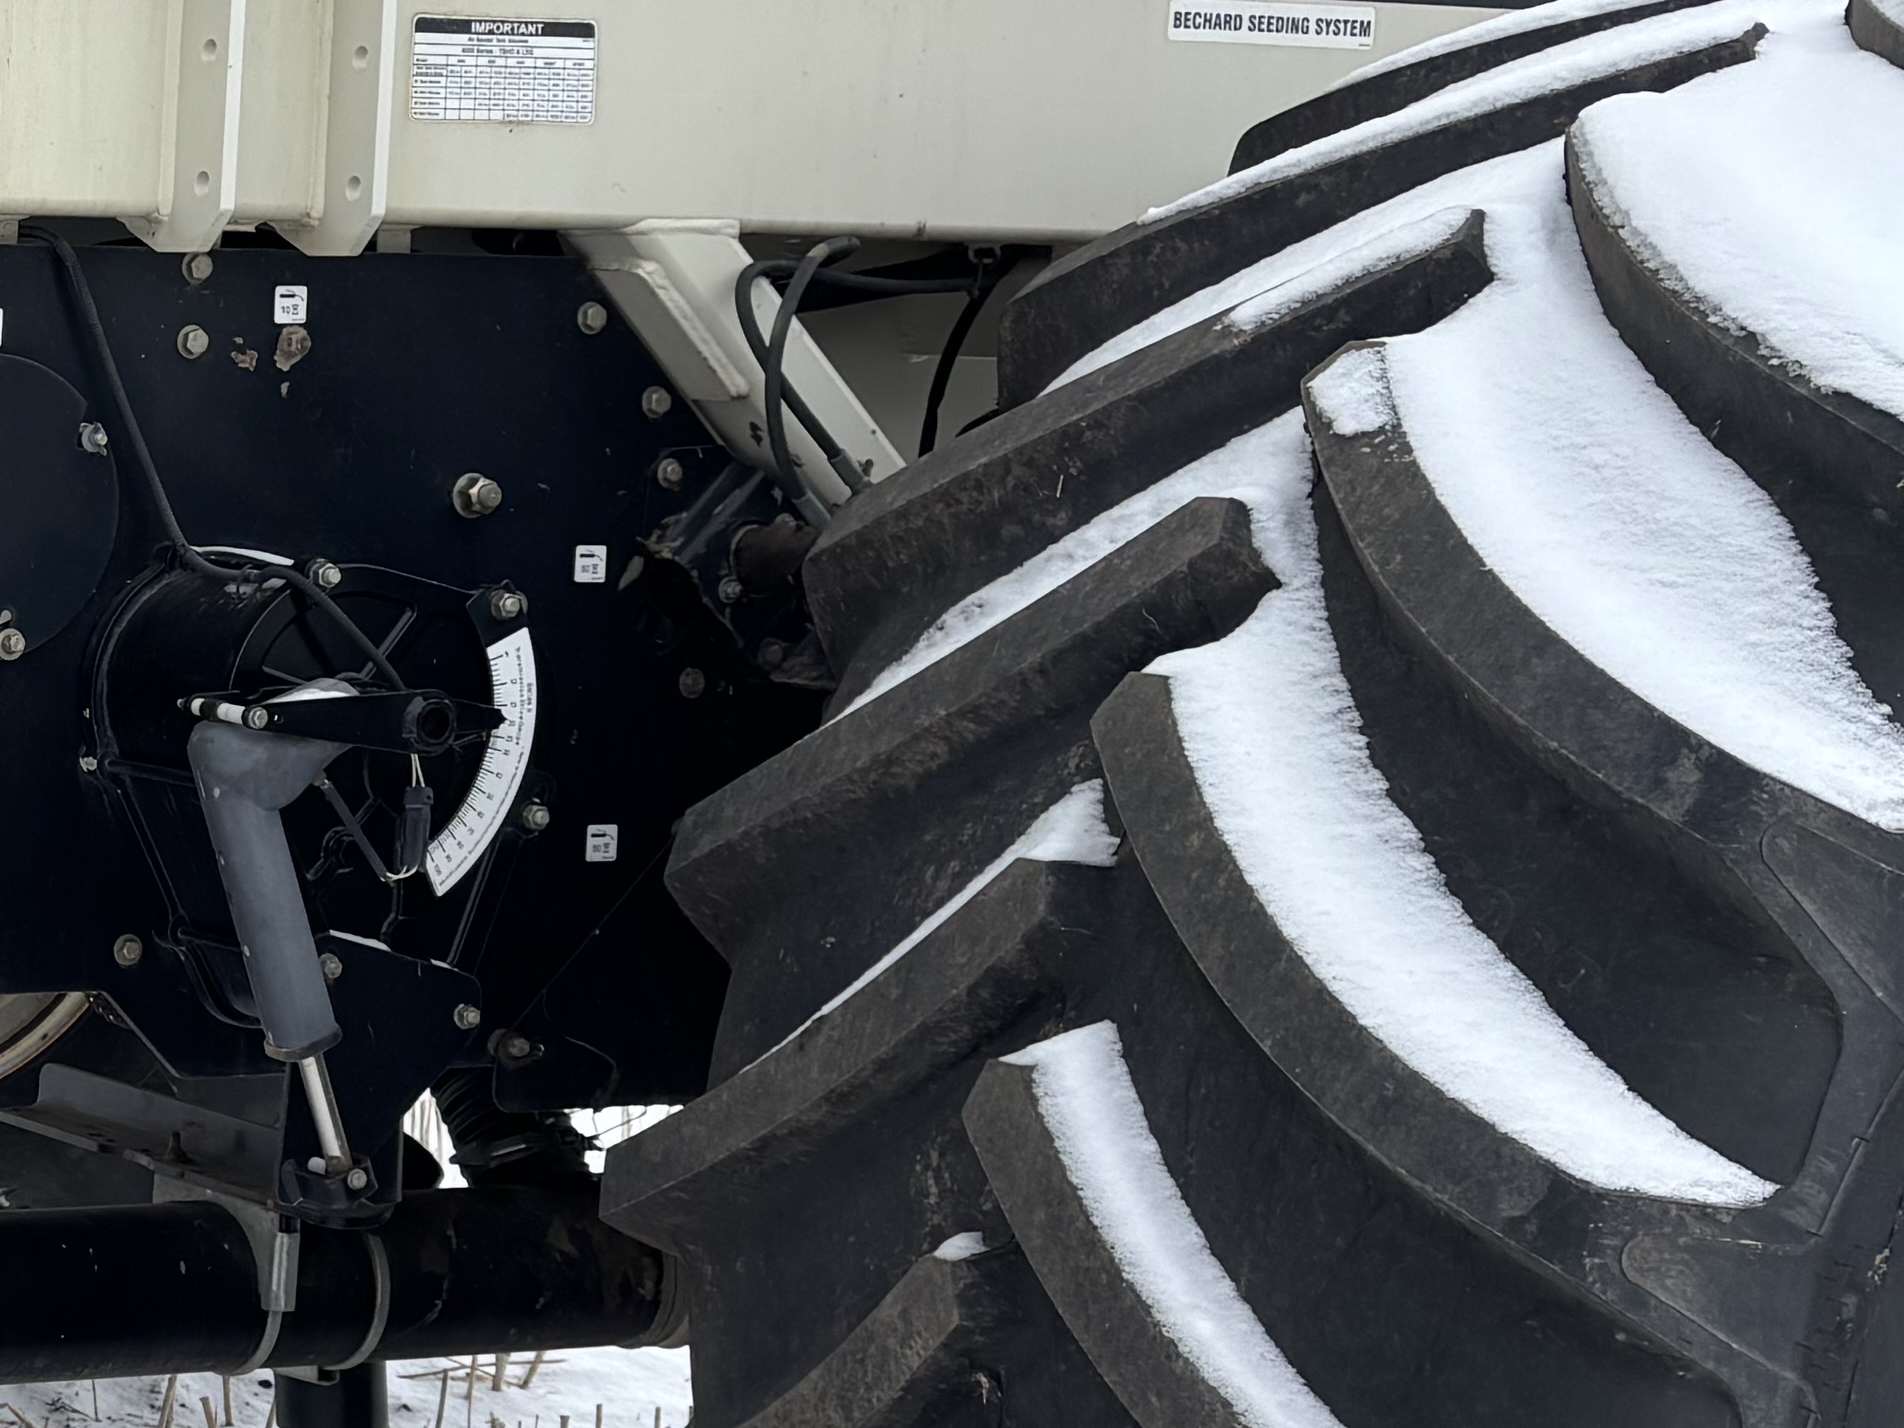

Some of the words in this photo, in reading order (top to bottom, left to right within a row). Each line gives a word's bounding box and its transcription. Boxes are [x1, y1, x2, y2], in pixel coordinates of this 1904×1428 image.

[471, 22, 545, 35] IMPORTANT
[1173, 11, 1243, 32] BECHARD
[1247, 15, 1310, 35] SEEDING
[1314, 18, 1372, 38] SYSTEM
